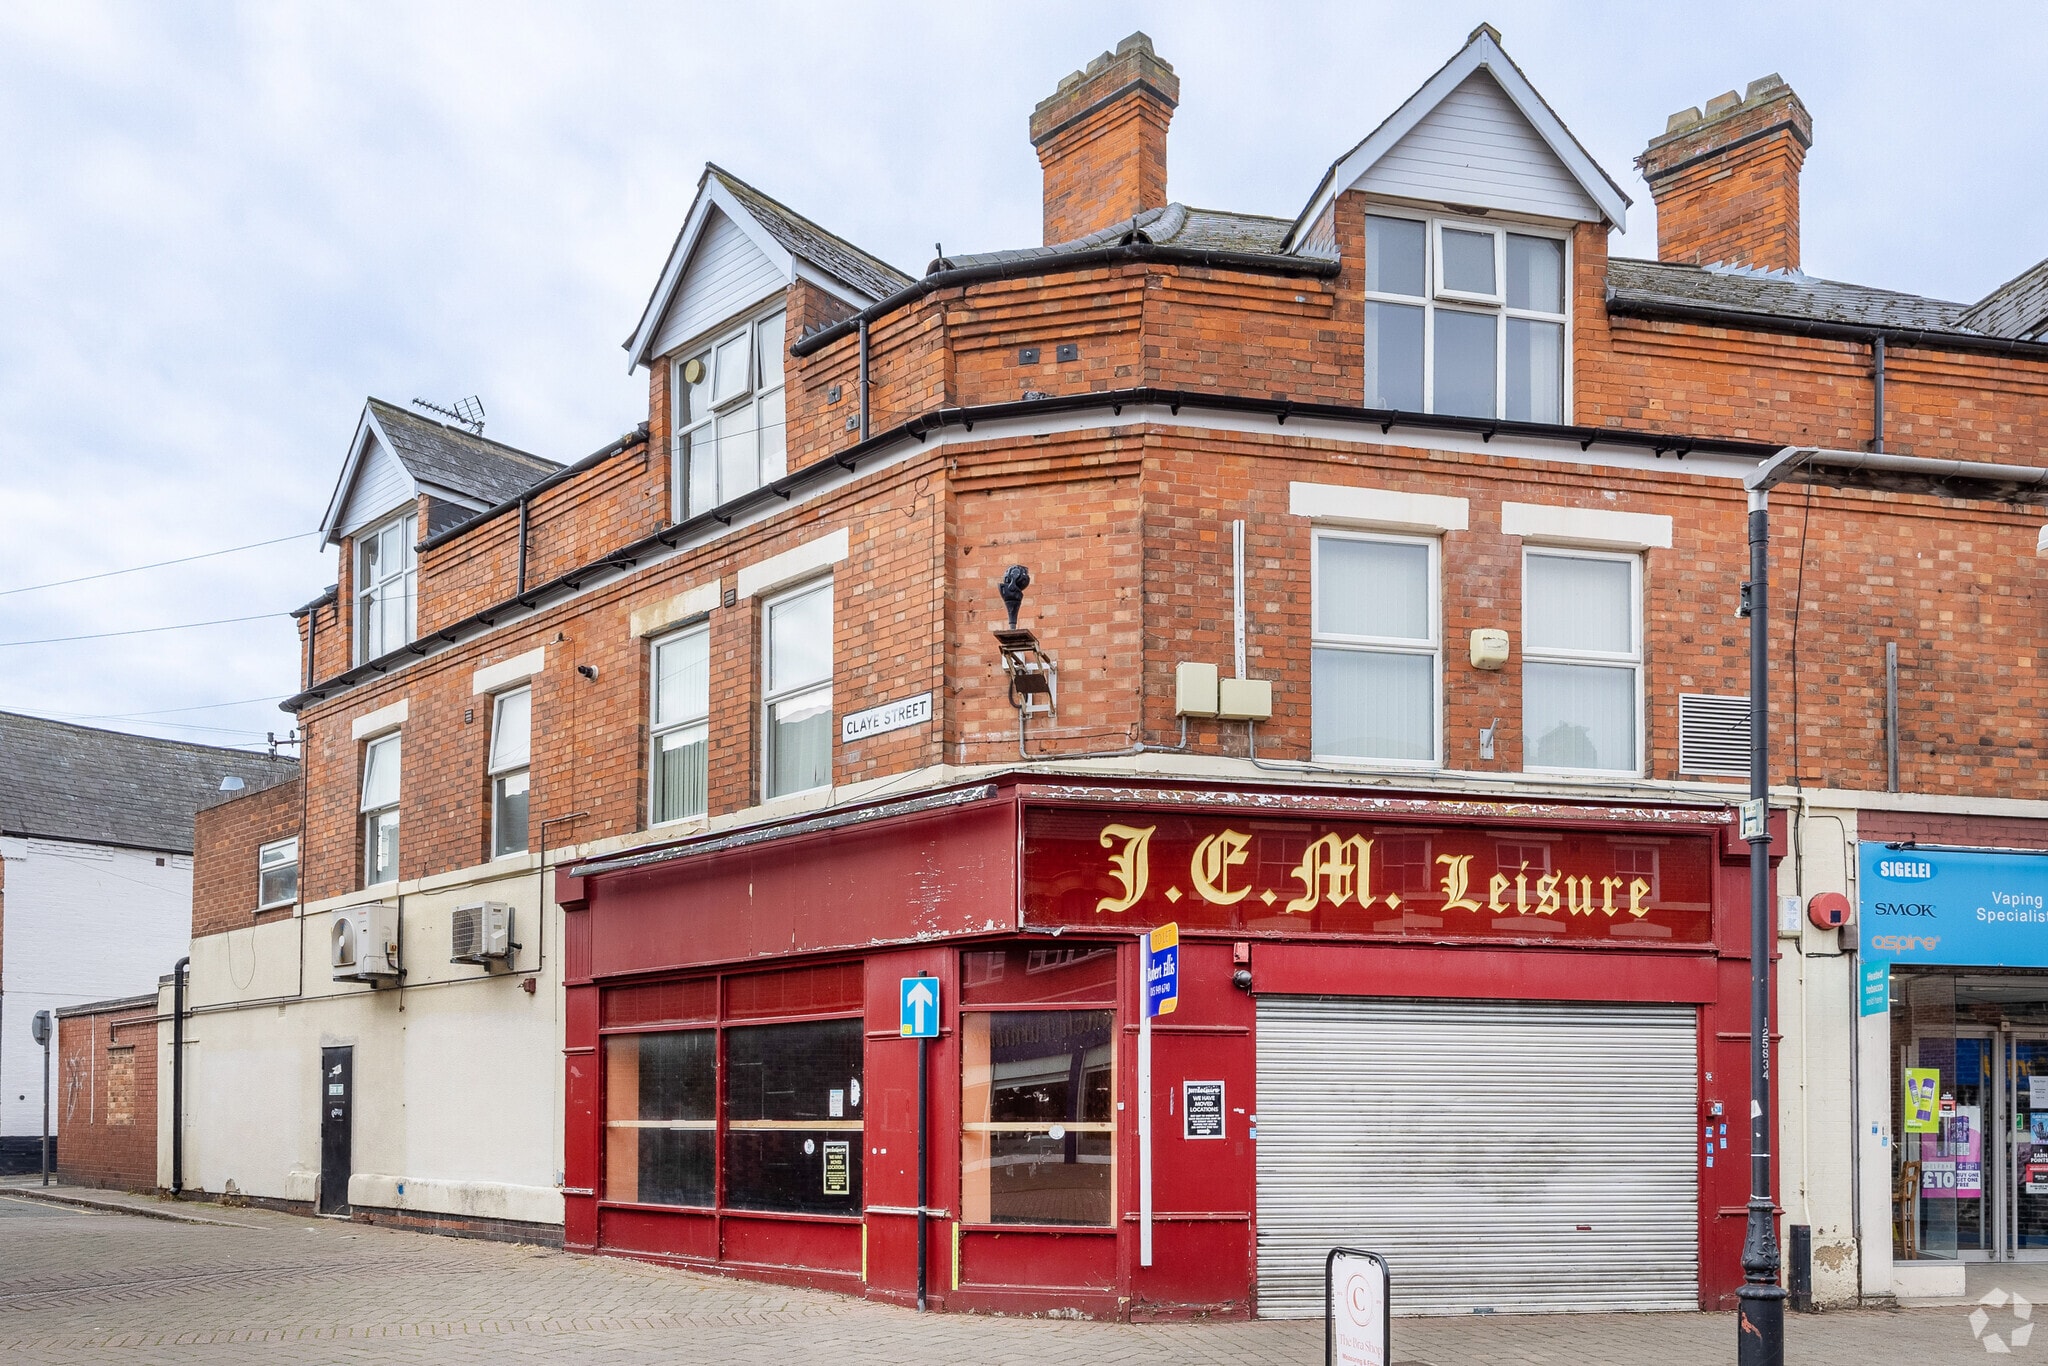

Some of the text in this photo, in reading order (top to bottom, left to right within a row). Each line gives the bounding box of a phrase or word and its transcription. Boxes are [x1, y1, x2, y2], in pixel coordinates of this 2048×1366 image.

[846, 700, 927, 735] CLAYE STREET
[1880, 861, 1931, 878] SIGELEI
[1434, 853, 1652, 919] Leisure
[1991, 891, 2043, 909] Vaping
[1875, 902, 1938, 918] SMOK
[1872, 935, 1936, 955] aspire
[1163, 954, 1175, 977] Ellis
[1922, 1171, 1955, 1189] £10
